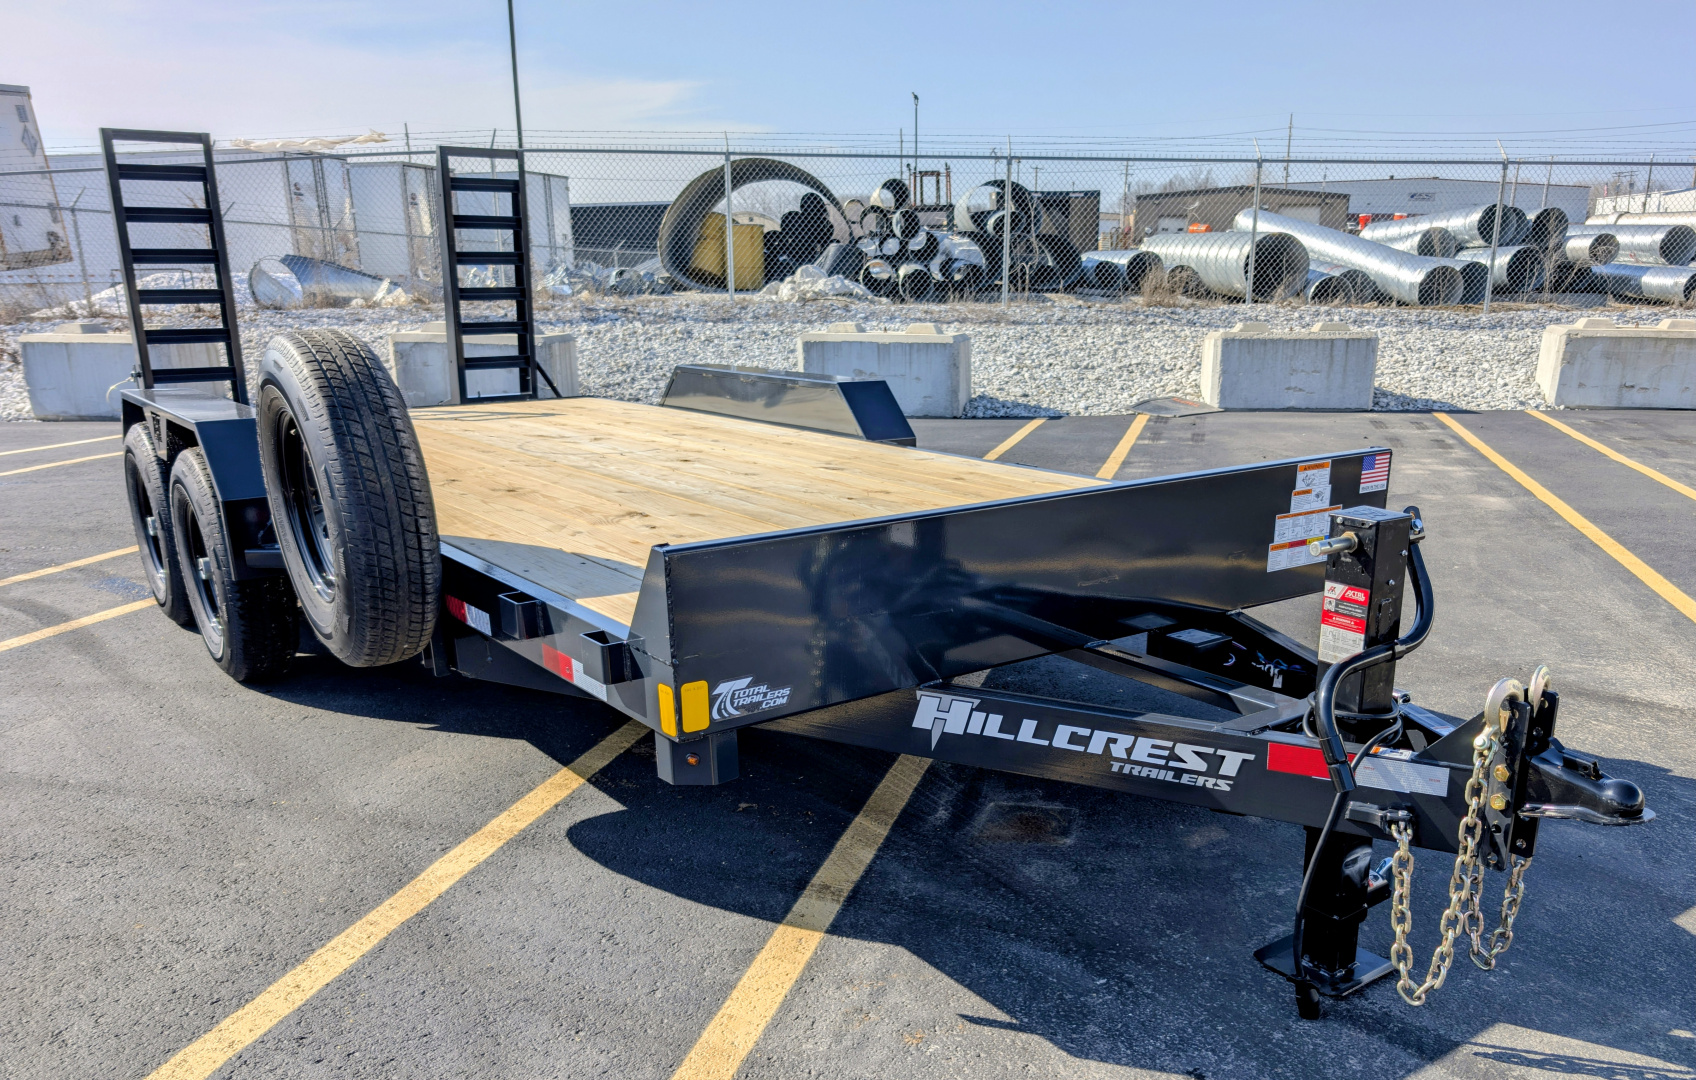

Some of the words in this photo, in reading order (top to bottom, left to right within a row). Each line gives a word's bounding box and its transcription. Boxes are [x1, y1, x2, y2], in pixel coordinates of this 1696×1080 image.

[733, 685, 771, 699] TOTAL
[733, 687, 791, 708] TRAILERS
[760, 696, 788, 709] .COM
[911, 690, 1256, 778] HILLCREST
[1110, 761, 1235, 792] TRAILERS
